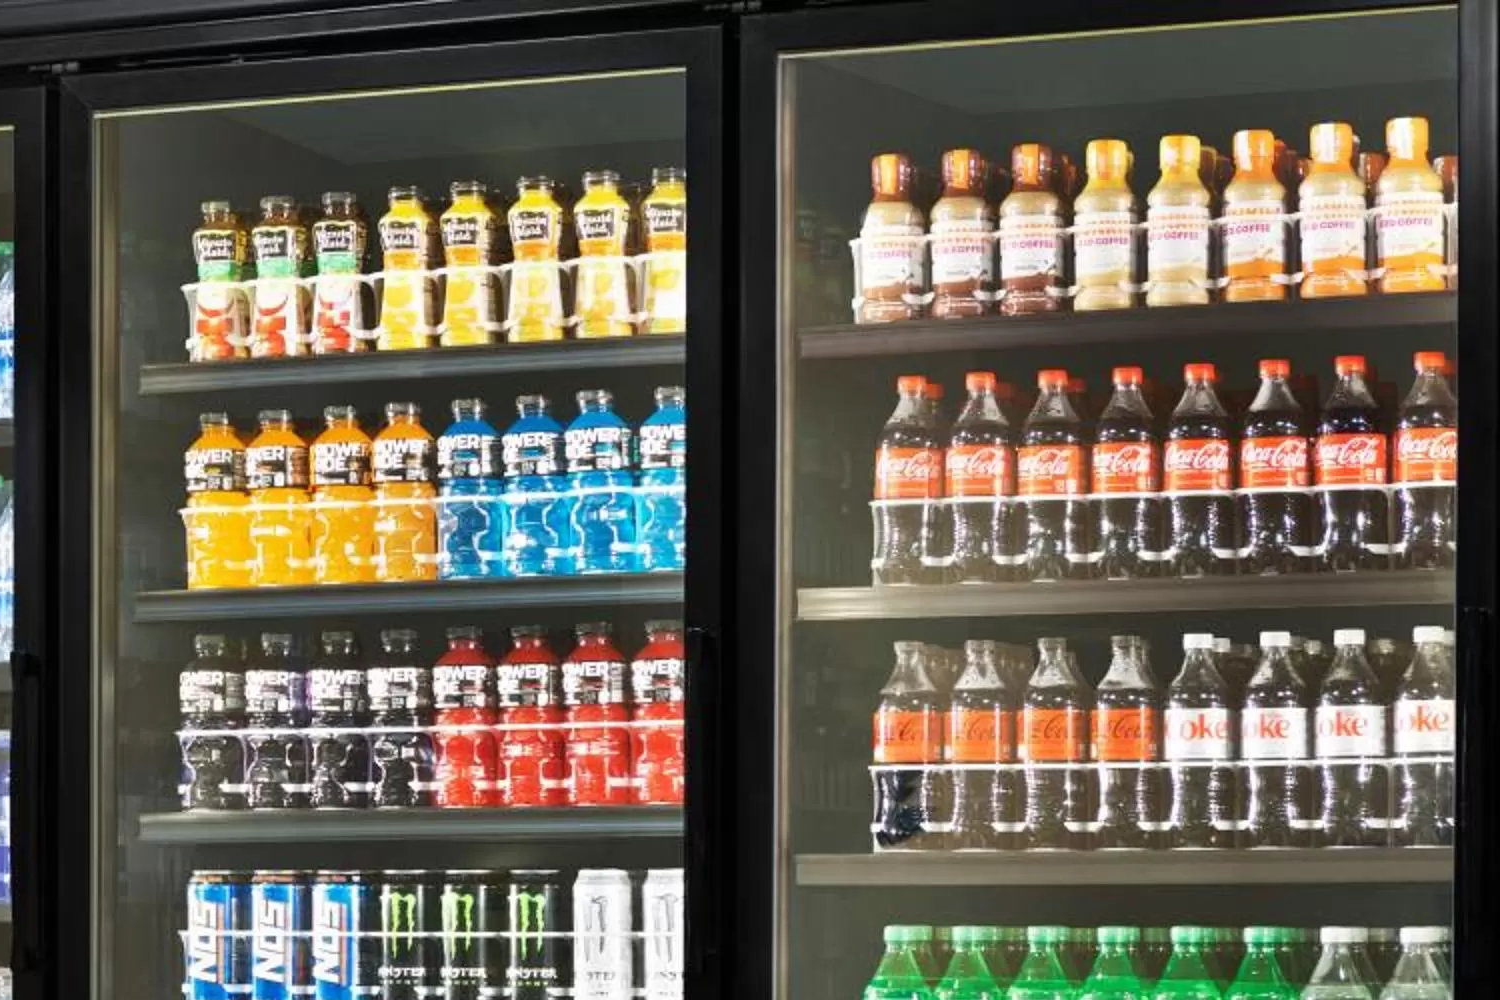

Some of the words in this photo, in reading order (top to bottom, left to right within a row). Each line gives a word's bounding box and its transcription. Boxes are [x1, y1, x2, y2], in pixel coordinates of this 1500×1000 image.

[1180, 713, 1230, 741] oke
[1244, 711, 1292, 738] oke
[1319, 710, 1368, 737] oke
[1400, 705, 1449, 733] oke
[189, 899, 218, 983] NOS
[254, 899, 286, 983] NOS
[314, 900, 342, 984] NOS
